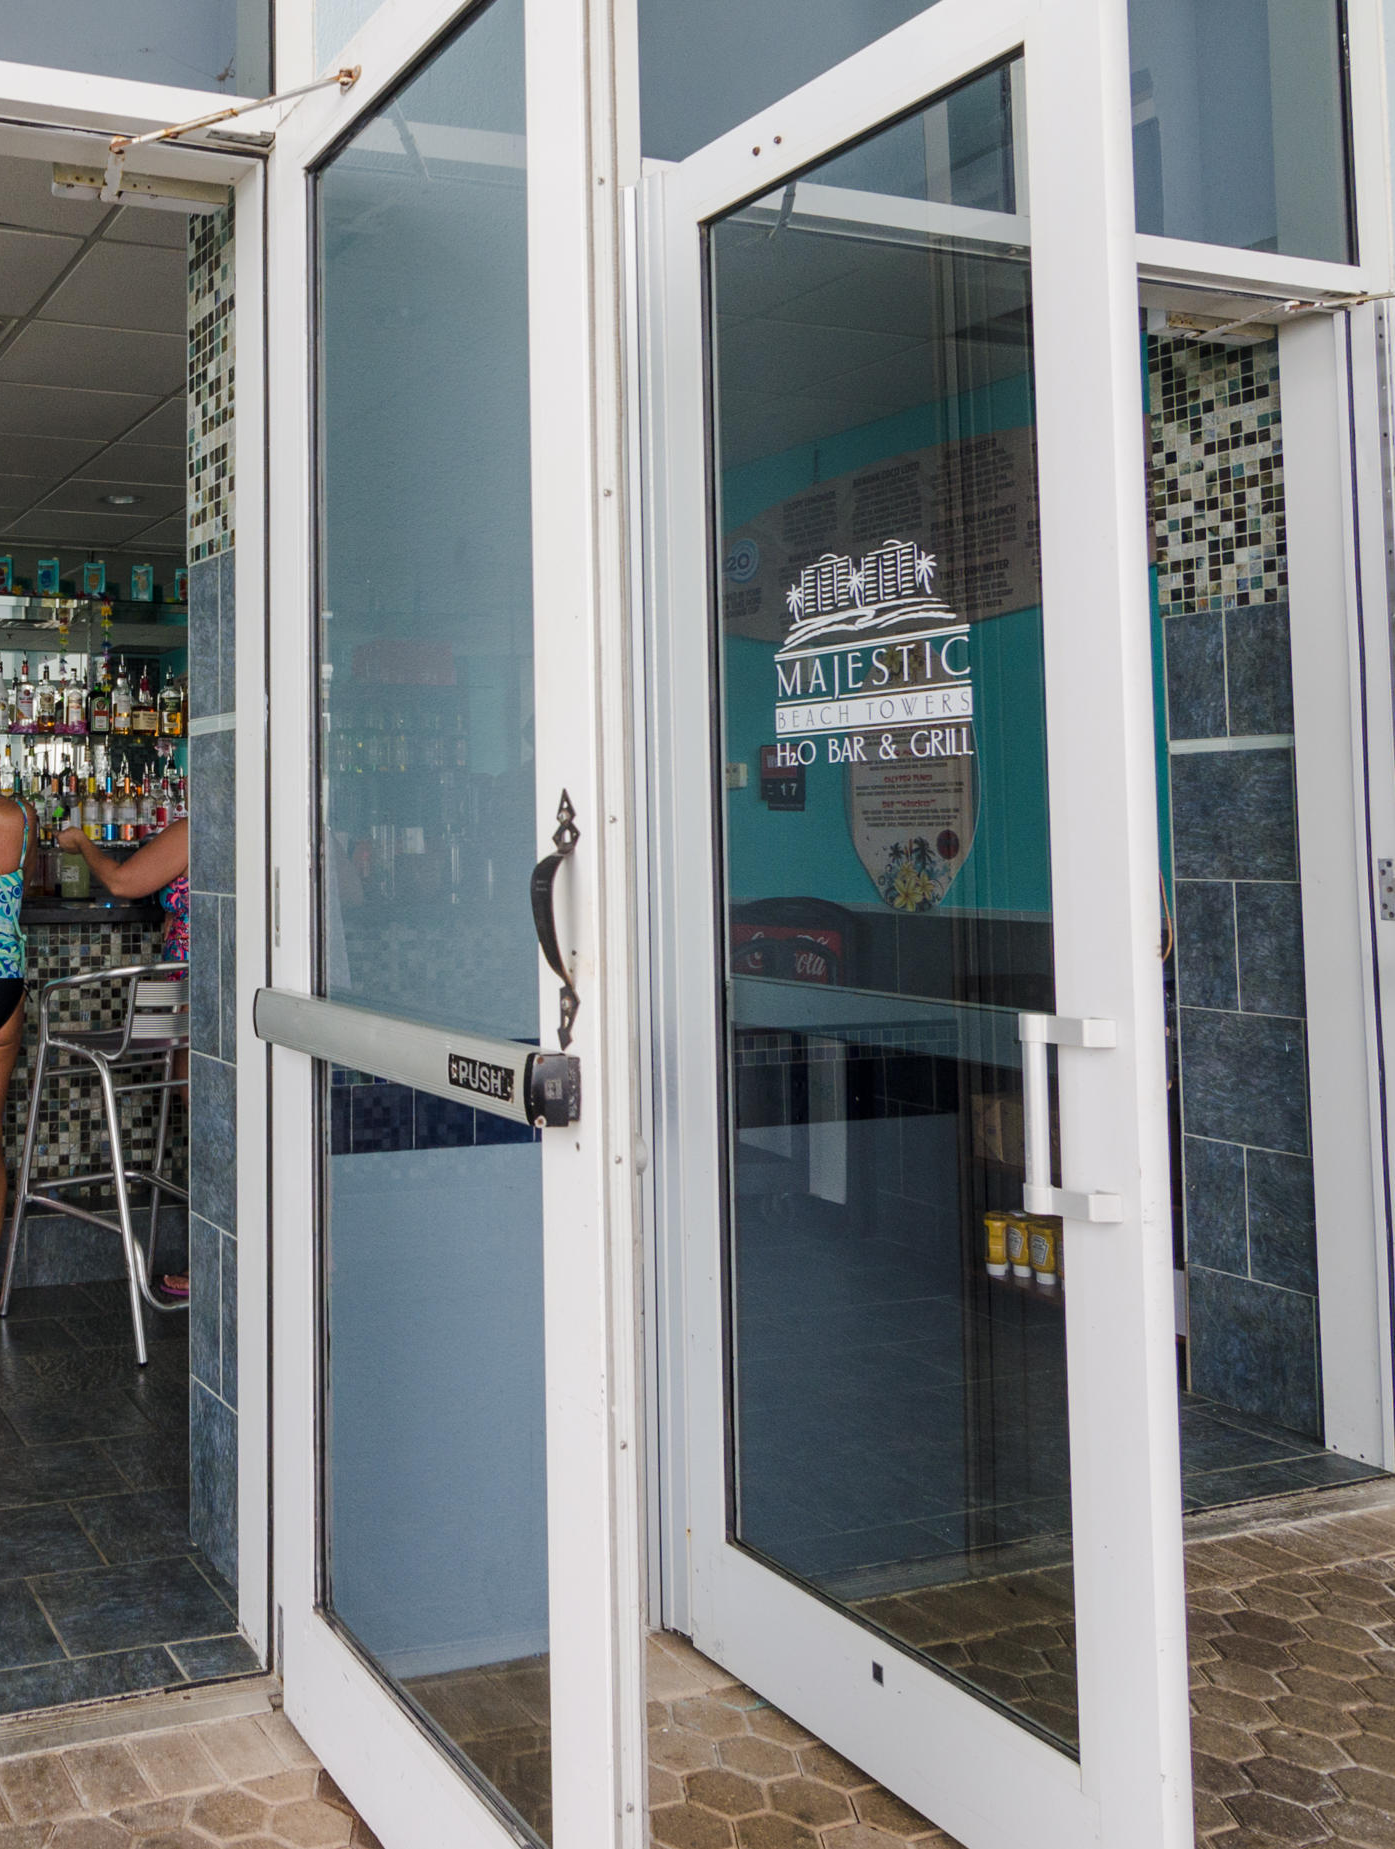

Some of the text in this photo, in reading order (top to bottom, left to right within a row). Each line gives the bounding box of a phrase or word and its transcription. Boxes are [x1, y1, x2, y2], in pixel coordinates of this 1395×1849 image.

[776, 635, 972, 700] MAJESTIC
[777, 690, 971, 731] BEACH TOWERS
[828, 735, 867, 764] BAR
[878, 733, 900, 760] &
[910, 727, 975, 758] GRILL
[459, 1061, 502, 1096] PUSH
